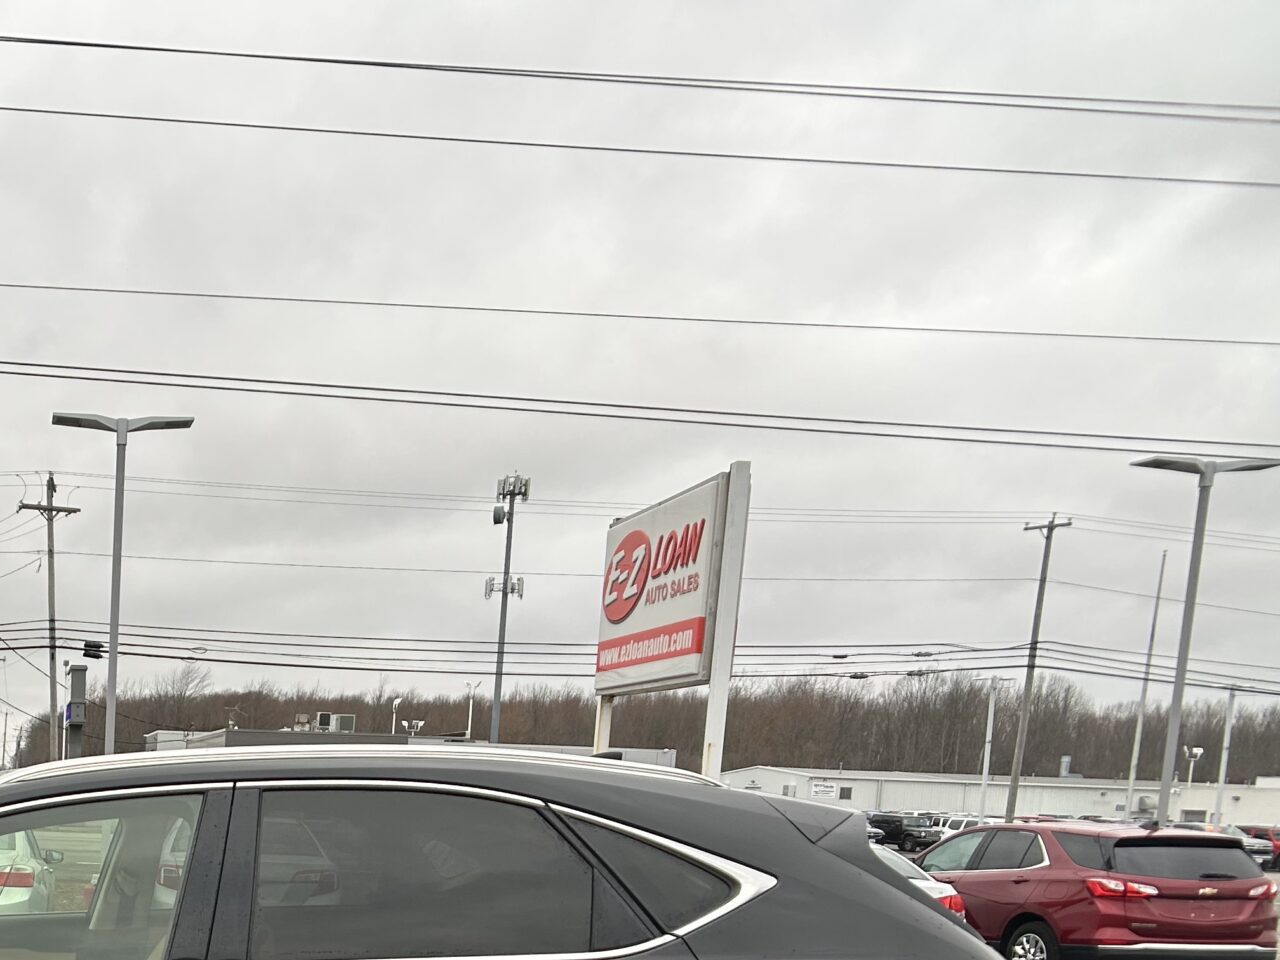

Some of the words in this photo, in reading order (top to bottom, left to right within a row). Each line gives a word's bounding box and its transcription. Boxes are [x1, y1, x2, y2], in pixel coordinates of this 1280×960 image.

[651, 518, 706, 579] LOAN
[644, 583, 668, 606] AUTO
[670, 572, 700, 598] SALES
[599, 629, 693, 667] www.ezloanauto.com
